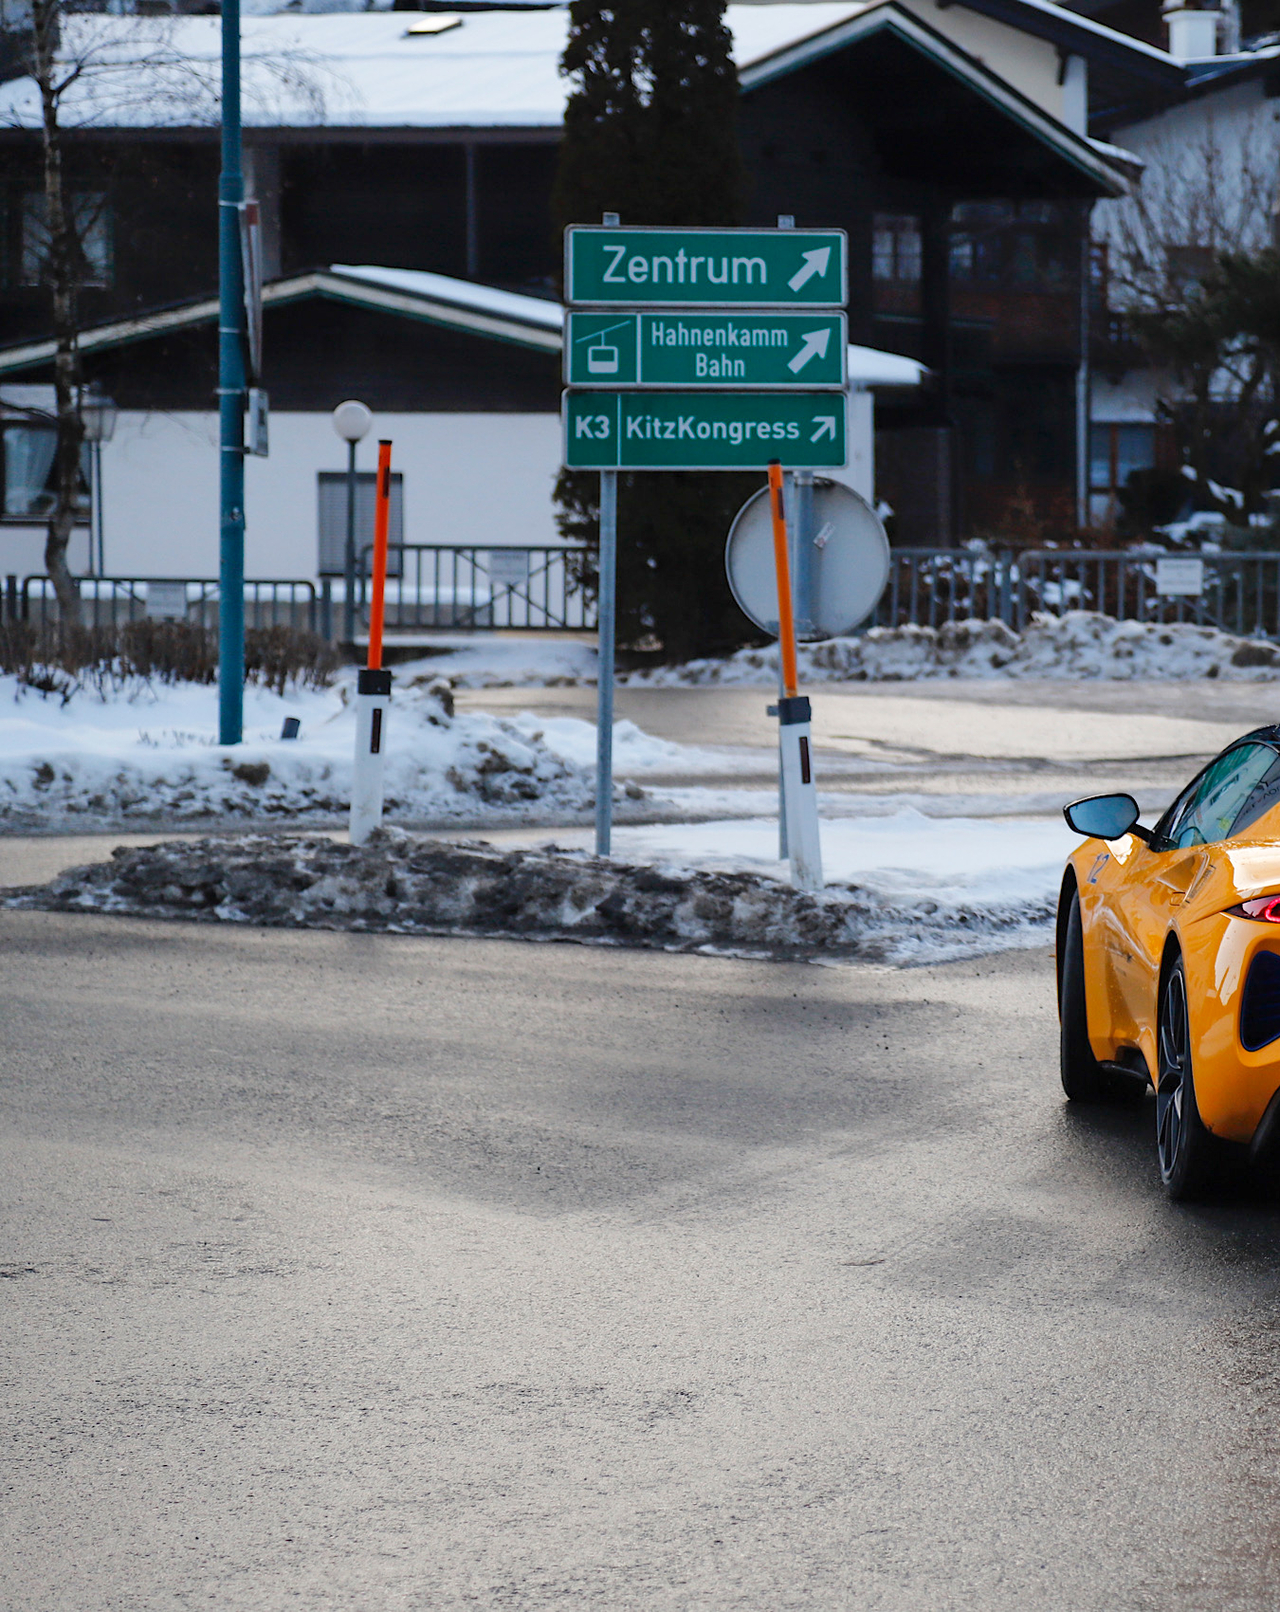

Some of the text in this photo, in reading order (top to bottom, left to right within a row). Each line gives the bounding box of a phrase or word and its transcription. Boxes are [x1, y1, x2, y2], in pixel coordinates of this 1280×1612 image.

[602, 244, 768, 285] Zentrum
[651, 321, 788, 347] Hahnenkamm
[695, 352, 746, 378] Bahn
[575, 414, 610, 438] K3
[626, 414, 800, 444] KitzKongress
